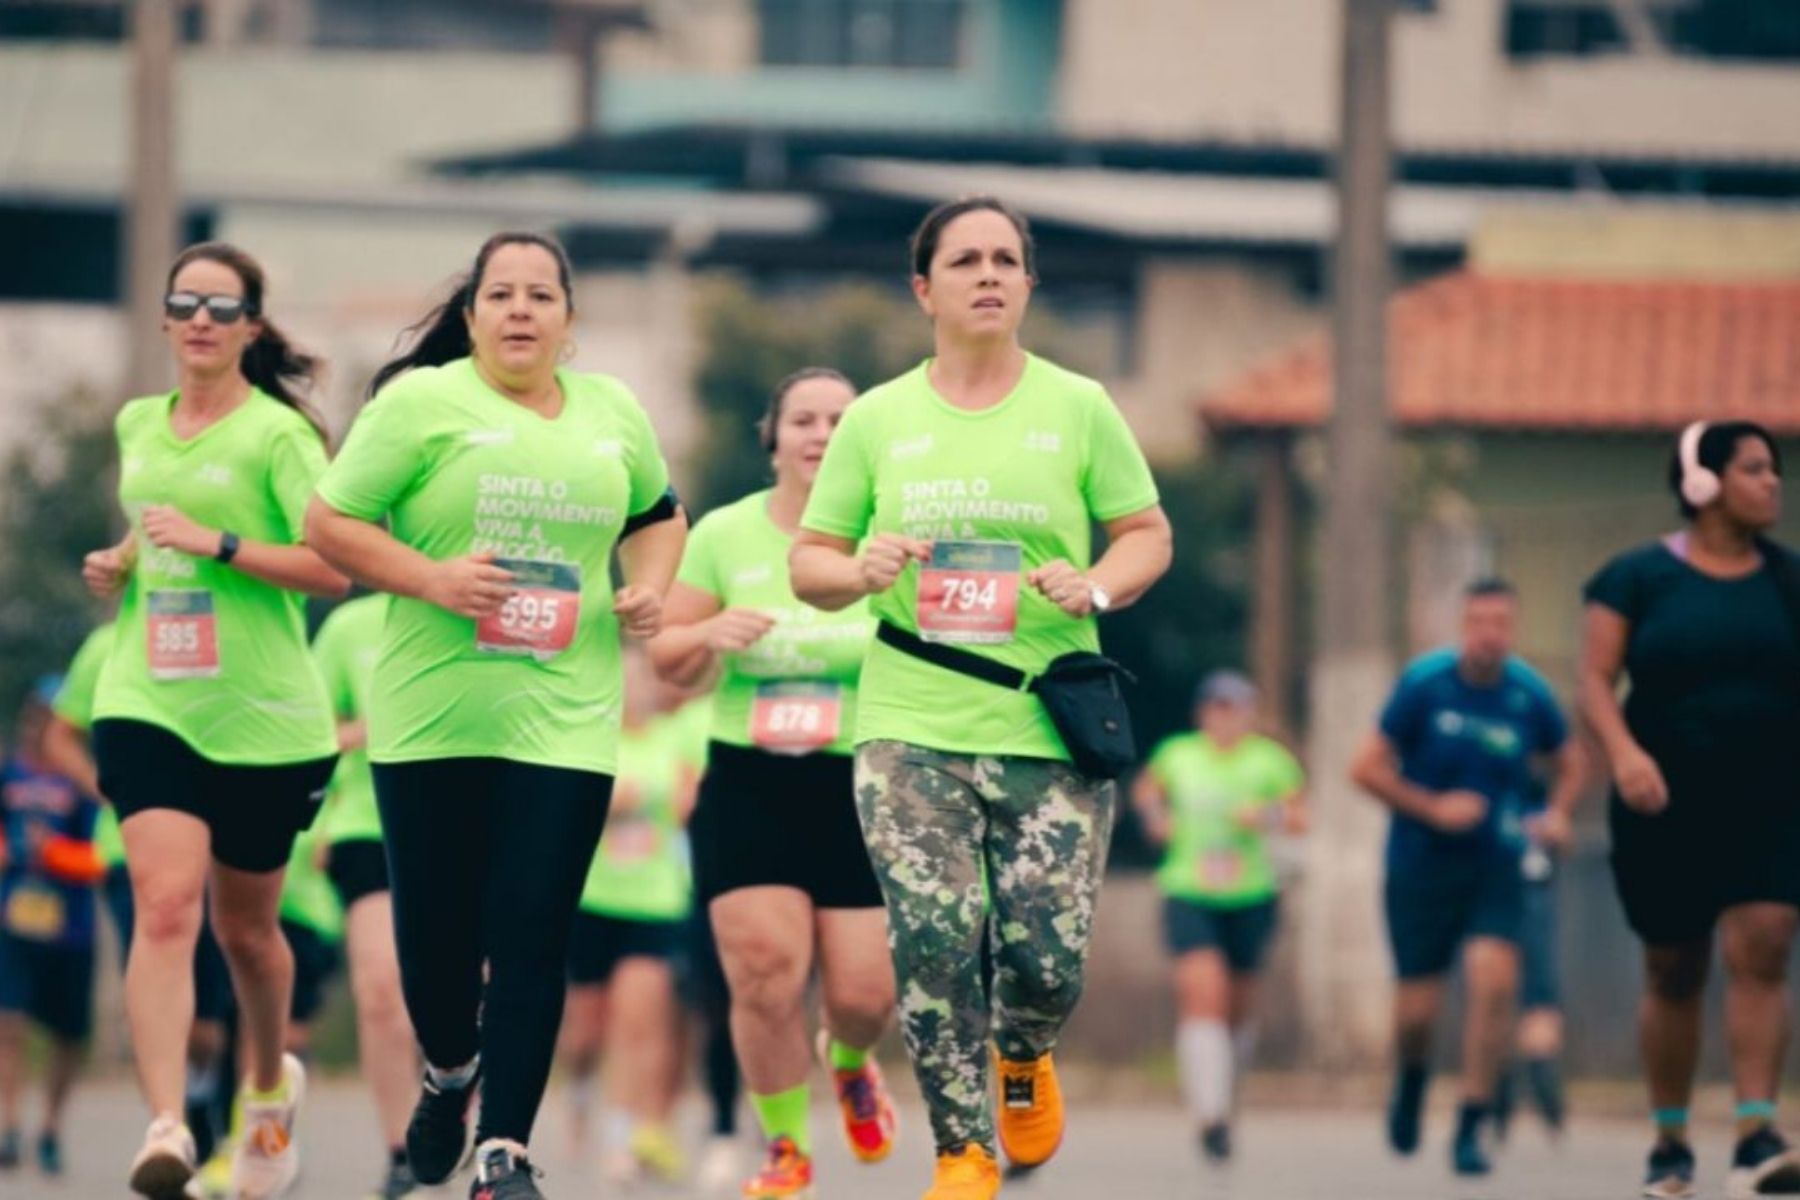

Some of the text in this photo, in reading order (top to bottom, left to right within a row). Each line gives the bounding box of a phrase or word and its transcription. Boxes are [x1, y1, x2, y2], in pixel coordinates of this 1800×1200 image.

[478, 474, 567, 499] SINTA O
[902, 477, 990, 500] SINTA O
[476, 498, 617, 525] MOVIMENTO
[902, 501, 1048, 524] MOVIMENTO
[475, 518, 543, 540] VIVA A
[941, 578, 998, 611] 794
[500, 596, 559, 630] 595
[155, 622, 198, 652] 585
